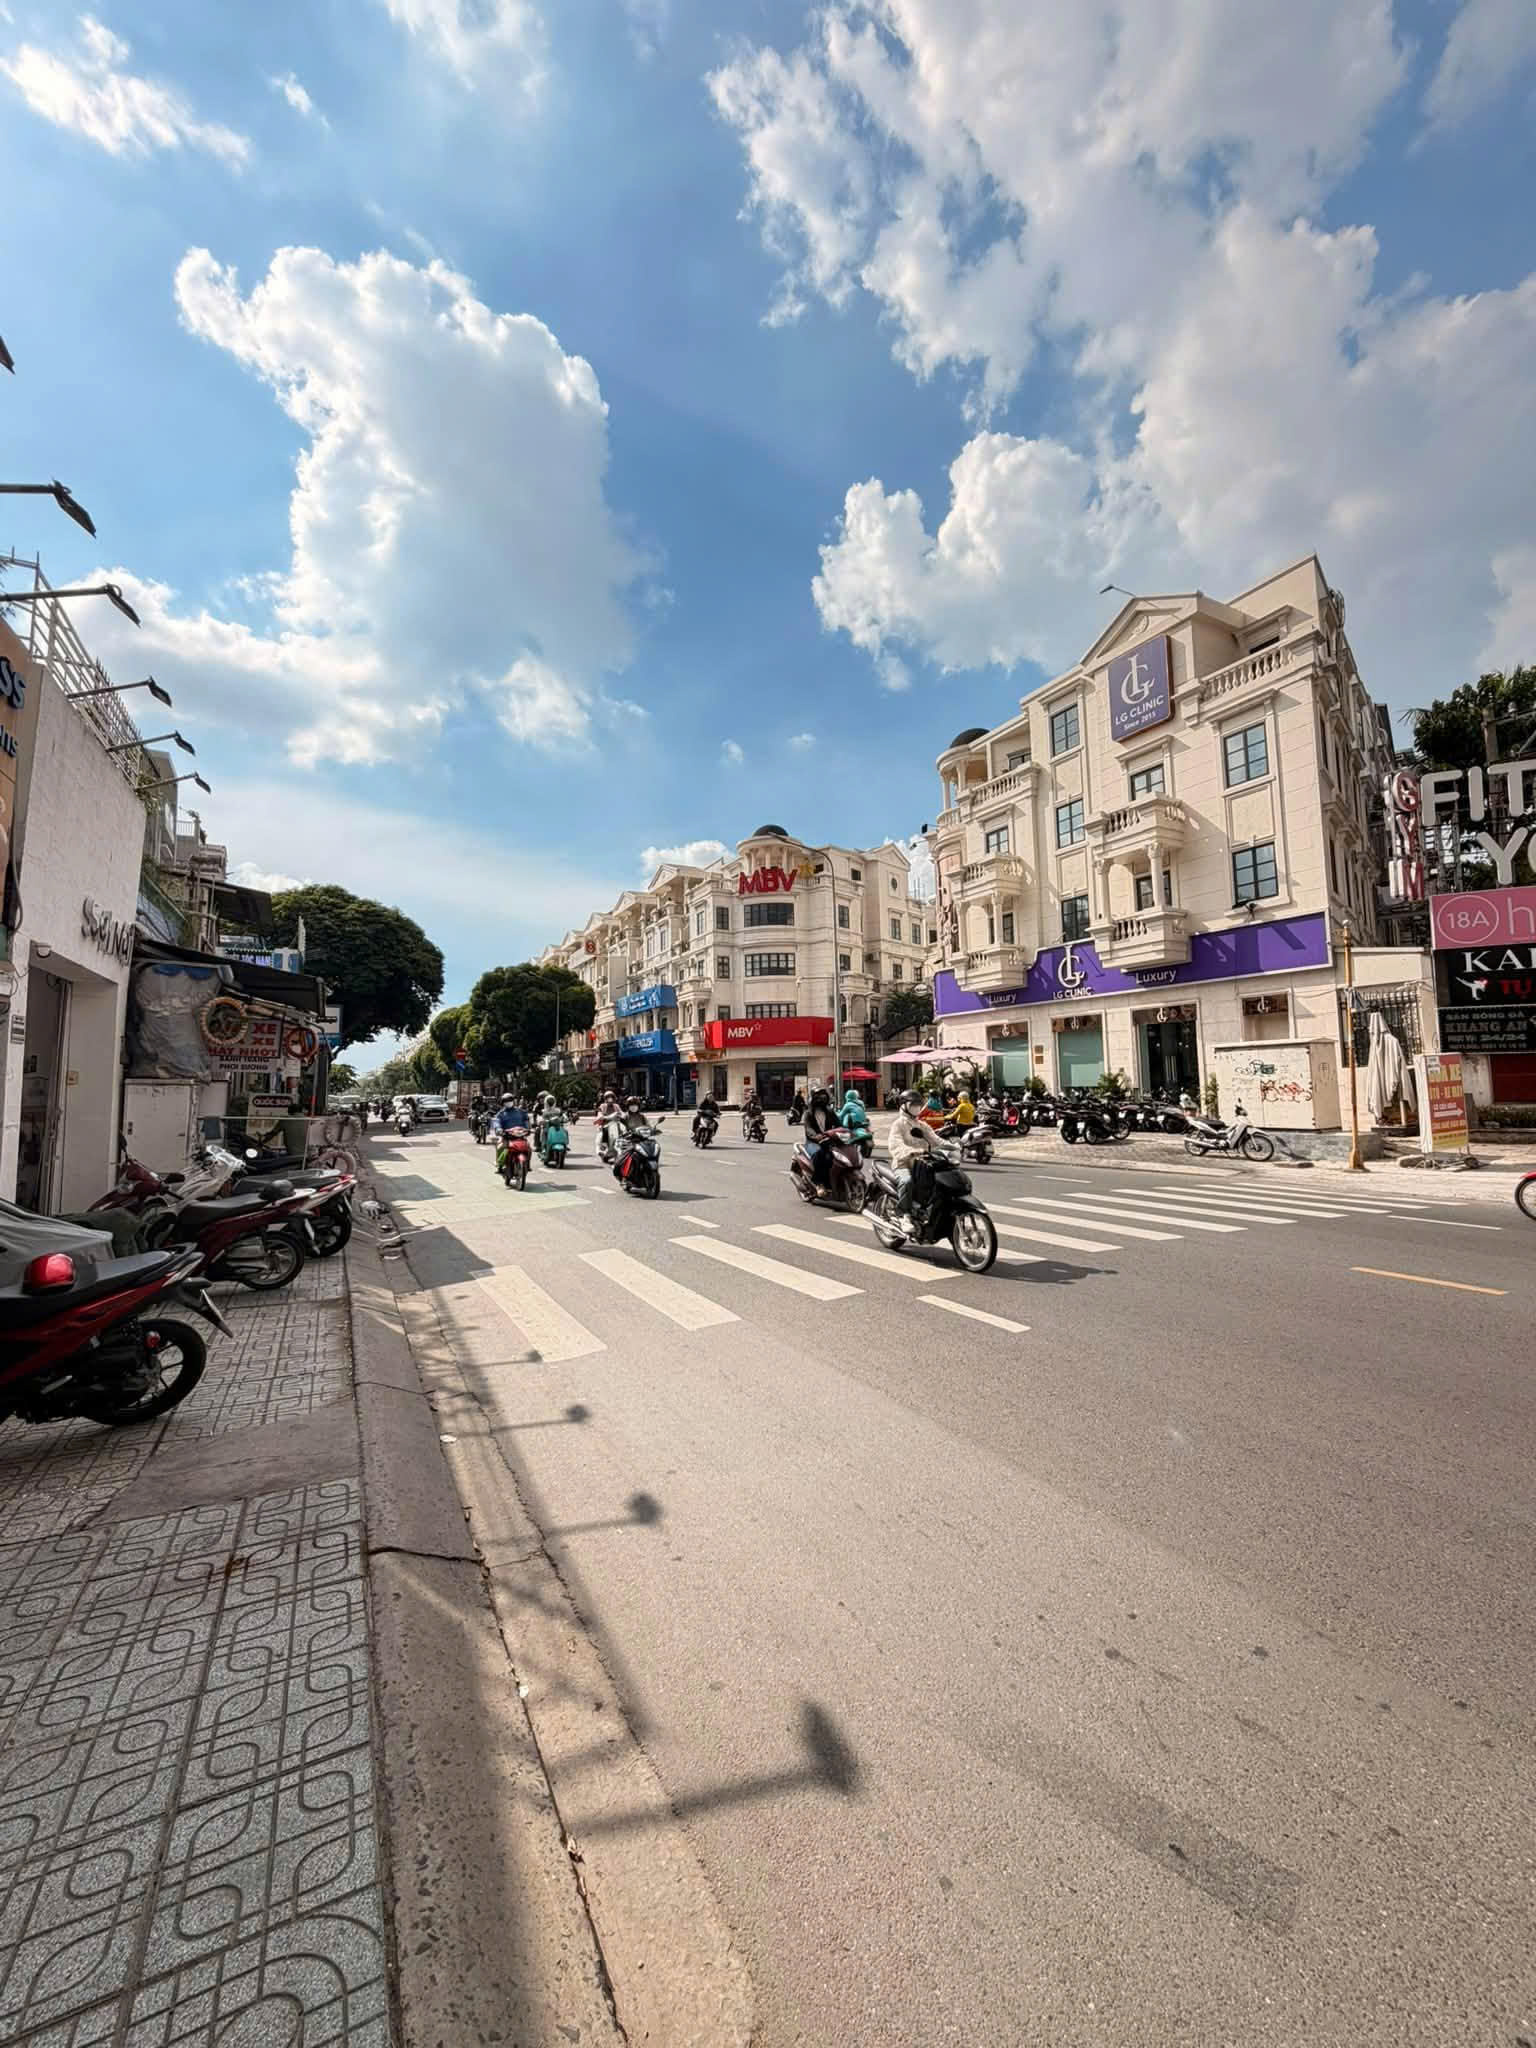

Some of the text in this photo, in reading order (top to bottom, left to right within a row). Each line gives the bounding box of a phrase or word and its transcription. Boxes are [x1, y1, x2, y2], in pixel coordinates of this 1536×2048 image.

[1115, 695, 1164, 726] LG CLINIC
[739, 867, 798, 895] MBV
[1447, 909, 1490, 929] 18A
[1135, 970, 1177, 984] Luxury
[989, 992, 1017, 1006] Luxury
[1053, 986, 1093, 999] LG CLINIC
[253, 1023, 277, 1035] XE
[728, 1024, 753, 1039] MBV
[253, 1037, 275, 1046] XE
